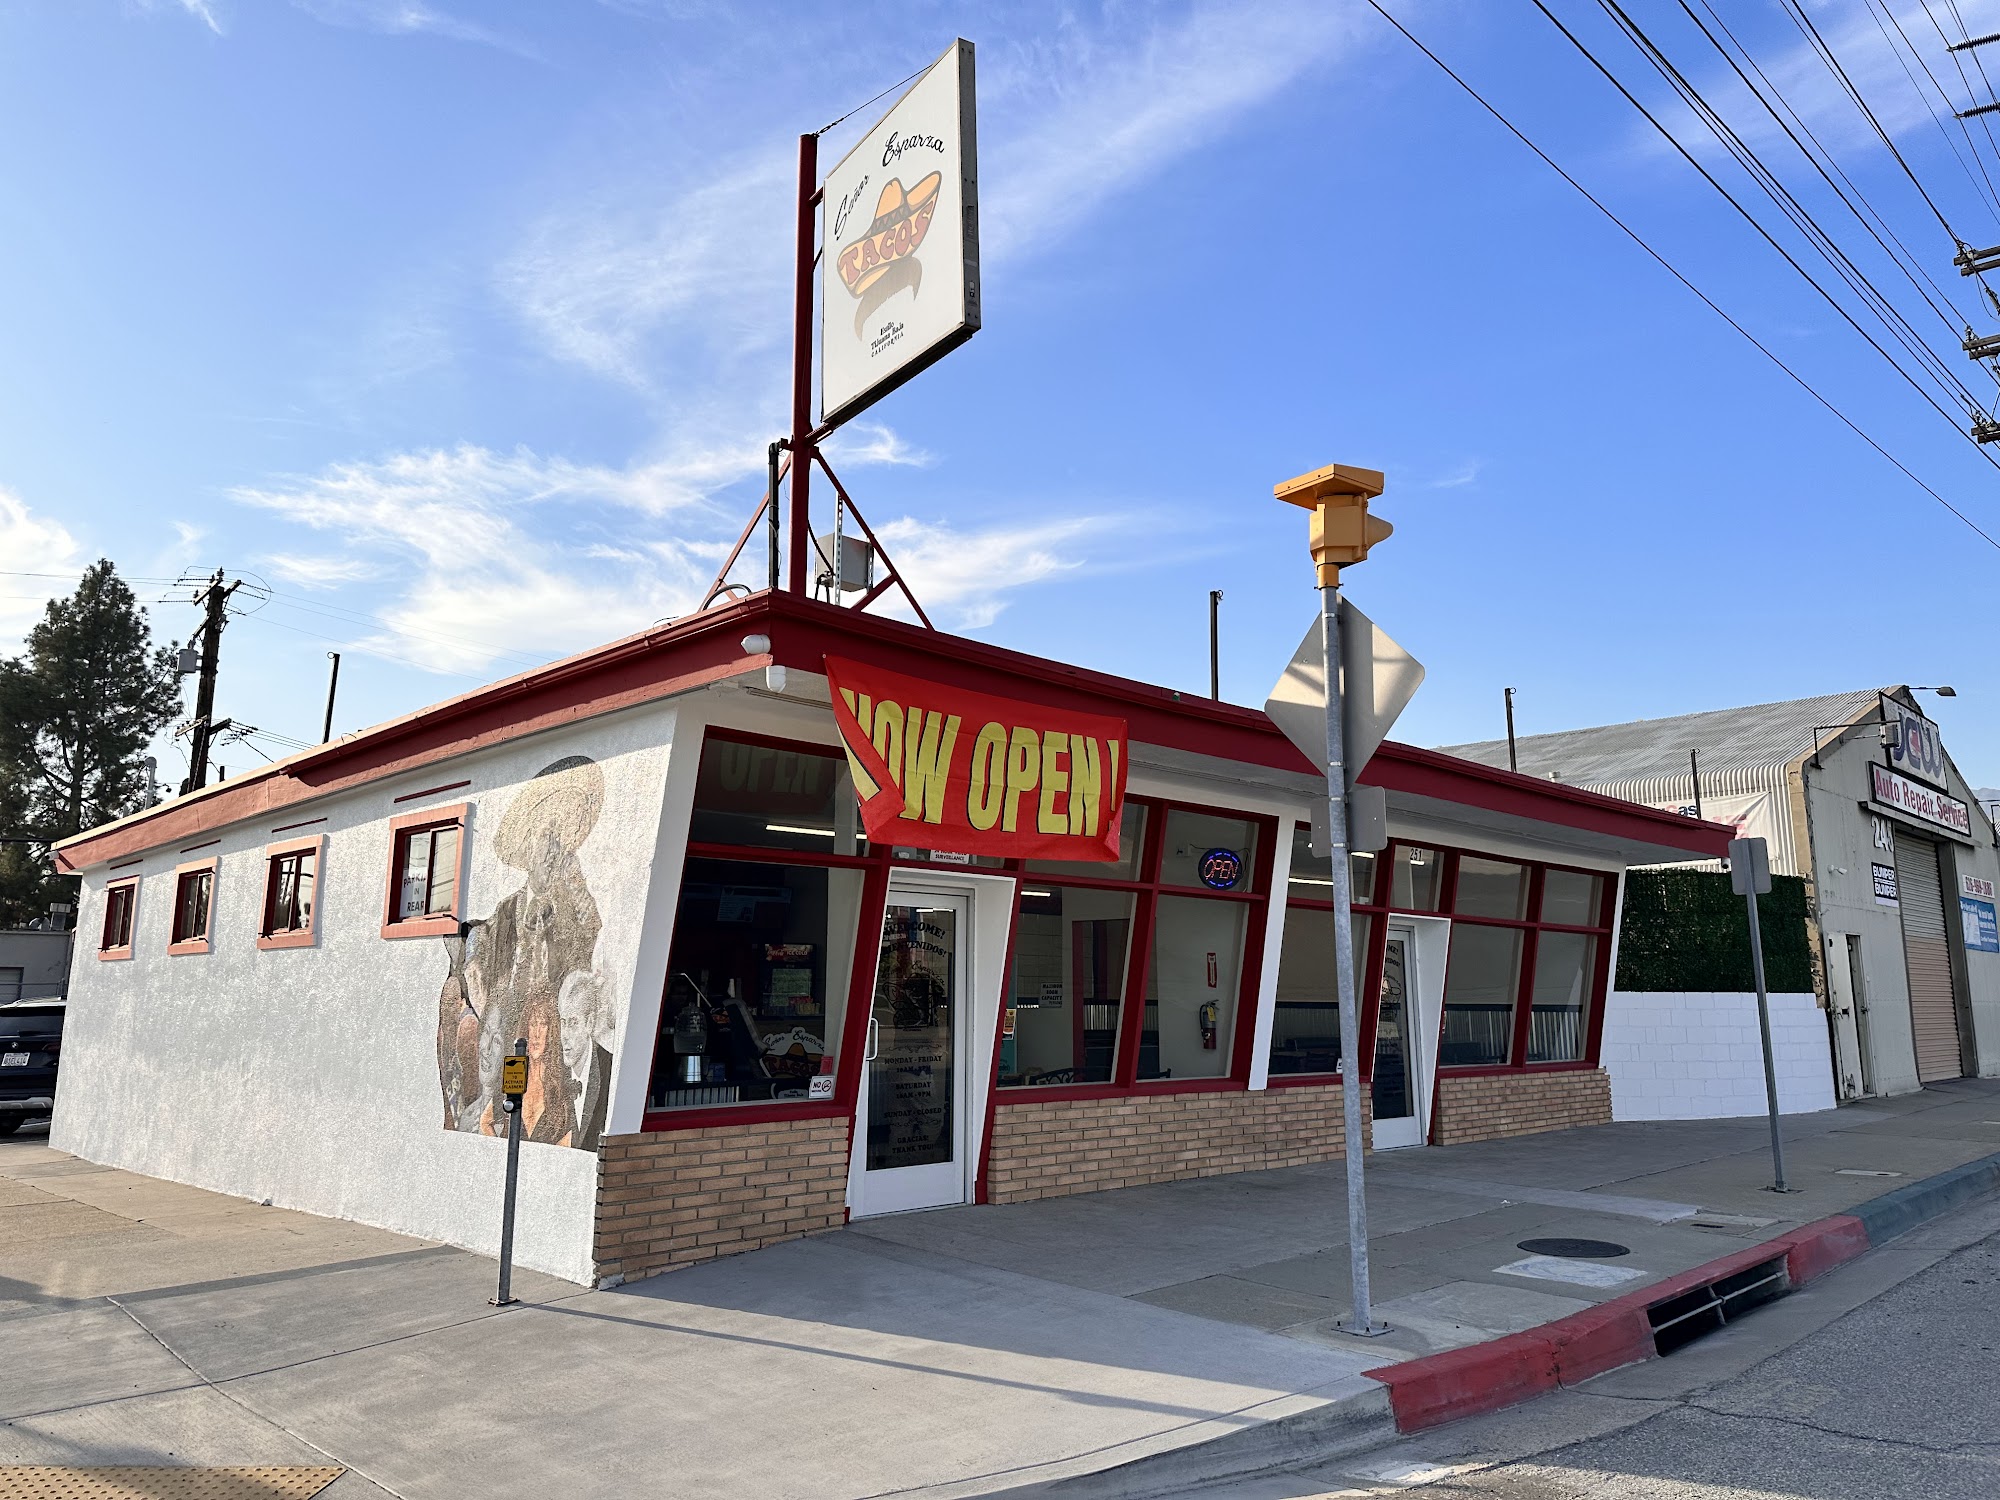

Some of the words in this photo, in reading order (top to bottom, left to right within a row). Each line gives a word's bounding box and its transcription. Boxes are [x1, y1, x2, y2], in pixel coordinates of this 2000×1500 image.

[881, 131, 944, 167] Esparza
[840, 200, 934, 285] TACOS
[871, 332, 904, 358] CALIFORNIA
[1875, 769, 1900, 802] Auto
[1902, 781, 1934, 816] Repair
[1936, 795, 1968, 829] Service
[1410, 848, 1422, 861] 251
[1204, 859, 1240, 880] OPEN
[404, 873, 426, 888] PARKI
[896, 1082, 931, 1090] SATURDAY
[884, 1110, 911, 1118] SUNDAY
[916, 1108, 942, 1116] CLOSED
[892, 1146, 916, 1154] THANK
